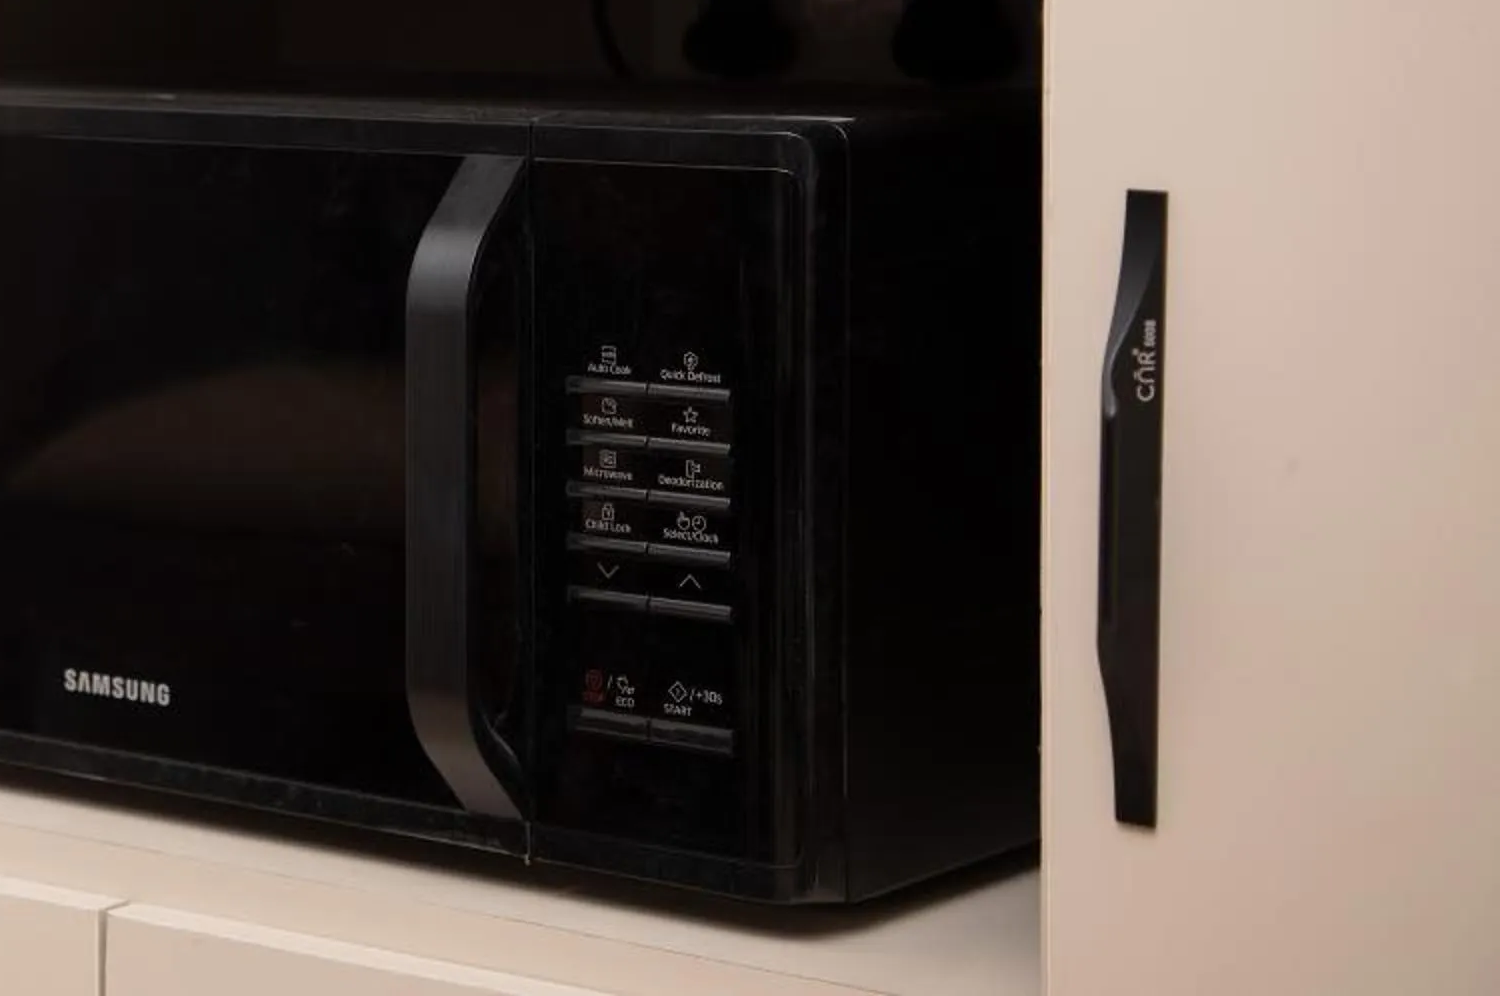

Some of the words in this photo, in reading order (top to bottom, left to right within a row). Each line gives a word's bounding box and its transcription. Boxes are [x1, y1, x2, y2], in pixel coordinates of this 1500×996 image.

[660, 369, 685, 381] Quick
[671, 422, 711, 437] Favorite
[583, 466, 633, 481] Microwave
[658, 475, 724, 491] Deodorization
[63, 668, 171, 707] SAMSUNG
[663, 703, 694, 717] START
